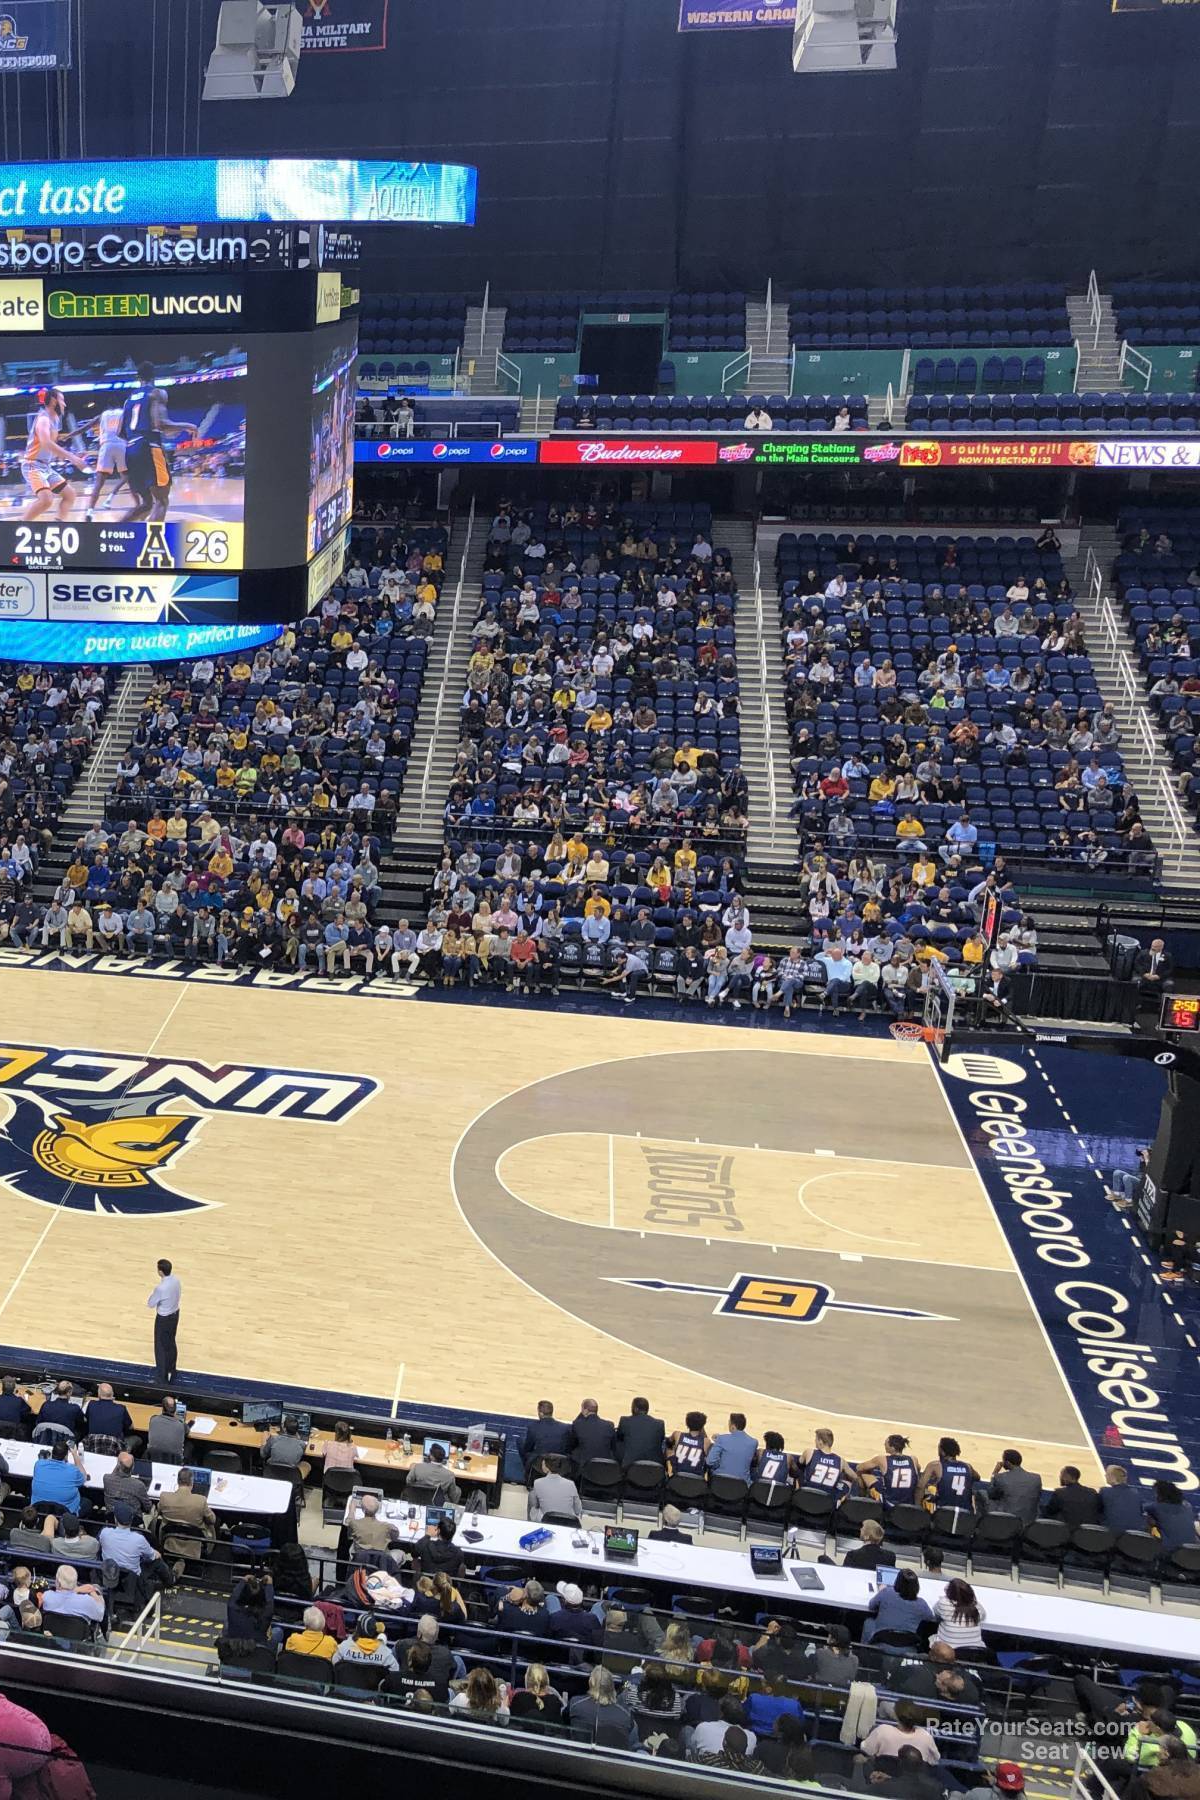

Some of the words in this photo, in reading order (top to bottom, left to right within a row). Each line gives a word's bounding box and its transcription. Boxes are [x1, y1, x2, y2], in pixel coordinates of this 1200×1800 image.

[687, 11, 753, 24] WESTERN
[316, 23, 371, 37] MILITARY
[40, 178, 125, 215] taste
[97, 234, 247, 264] Coliseum
[48, 291, 150, 319] GREEN
[152, 295, 242, 314] LINCOLN
[392, 447, 414, 457] pepsi
[449, 447, 470, 457] pepsi
[506, 447, 528, 457] pepsi
[577, 443, 682, 462] Budweiser
[763, 443, 809, 454] Charging
[811, 443, 856, 454] Stations
[951, 444, 1025, 455] southwest
[1030, 444, 1062, 457] grill
[1097, 443, 1166, 465] NEWS
[1171, 445, 1191, 465] &
[769, 454, 784, 462] the
[787, 454, 809, 463] Main
[811, 455, 861, 463] Concourse
[15, 526, 80, 554] 2:50
[100, 530, 107, 539] 4
[108, 531, 135, 539] FOULS
[100, 543, 107, 553] 3
[108, 545, 126, 553] TOL
[136, 522, 175, 569] A
[185, 530, 230, 564] 26
[25, 556, 52, 566] HALF
[56, 556, 62, 566] 1
[53, 584, 156, 603] SEGRA
[84, 636, 128, 656] pure
[131, 631, 181, 651] water,
[186, 624, 237, 651] perfect
[1173, 1000, 1199, 1012] 2:50
[1175, 1012, 1193, 1026] 15
[1035, 1034, 1067, 1043] SPALDING
[968, 1090, 1091, 1268] Greensboro
[641, 1146, 745, 1232] SOCON
[735, 1280, 819, 1317] G
[1054, 1281, 1200, 1491] Coliseum
[675, 1444, 701, 1467] 44
[761, 1460, 780, 1479] 0
[809, 1464, 840, 1487] 33
[891, 1468, 912, 1489] 13
[951, 1475, 966, 1496] 4
[345, 1650, 383, 1662] ALLEGRI
